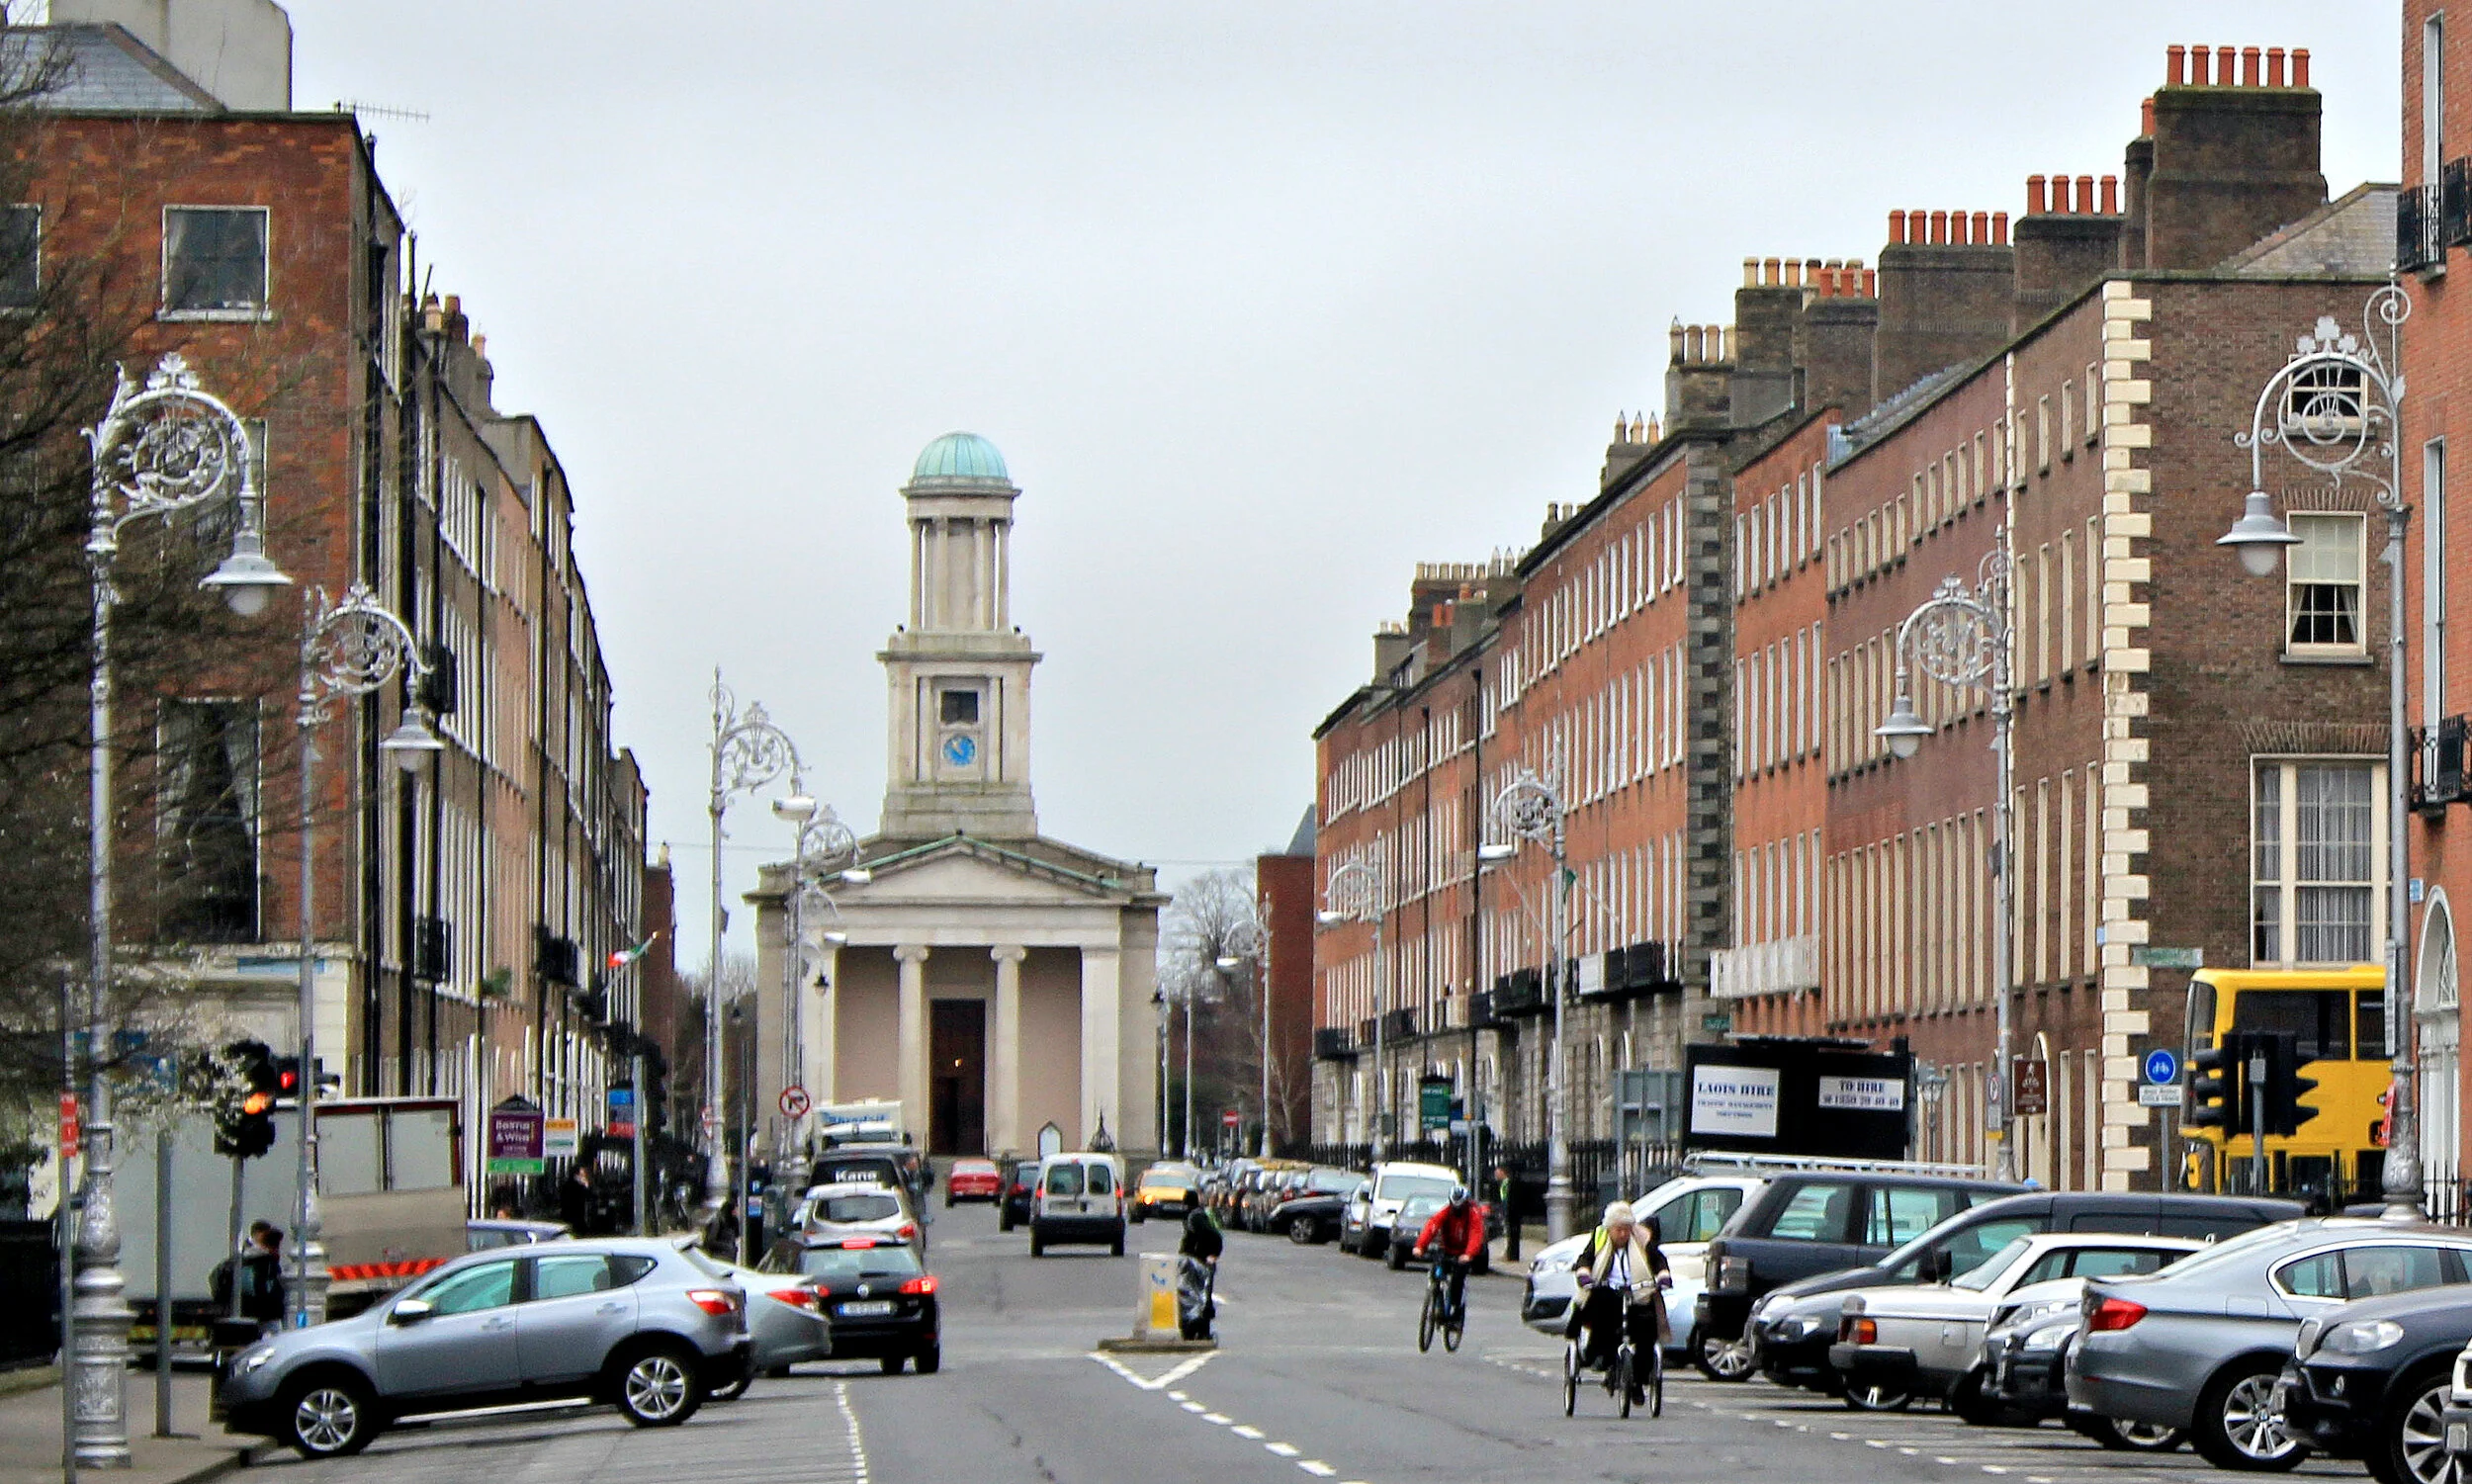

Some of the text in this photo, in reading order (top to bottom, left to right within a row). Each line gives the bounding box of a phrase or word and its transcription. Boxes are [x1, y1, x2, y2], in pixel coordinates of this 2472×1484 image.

[1698, 1081, 1775, 1096] LAOIS HIRE
[1840, 1081, 1885, 1092] TO HIRE
